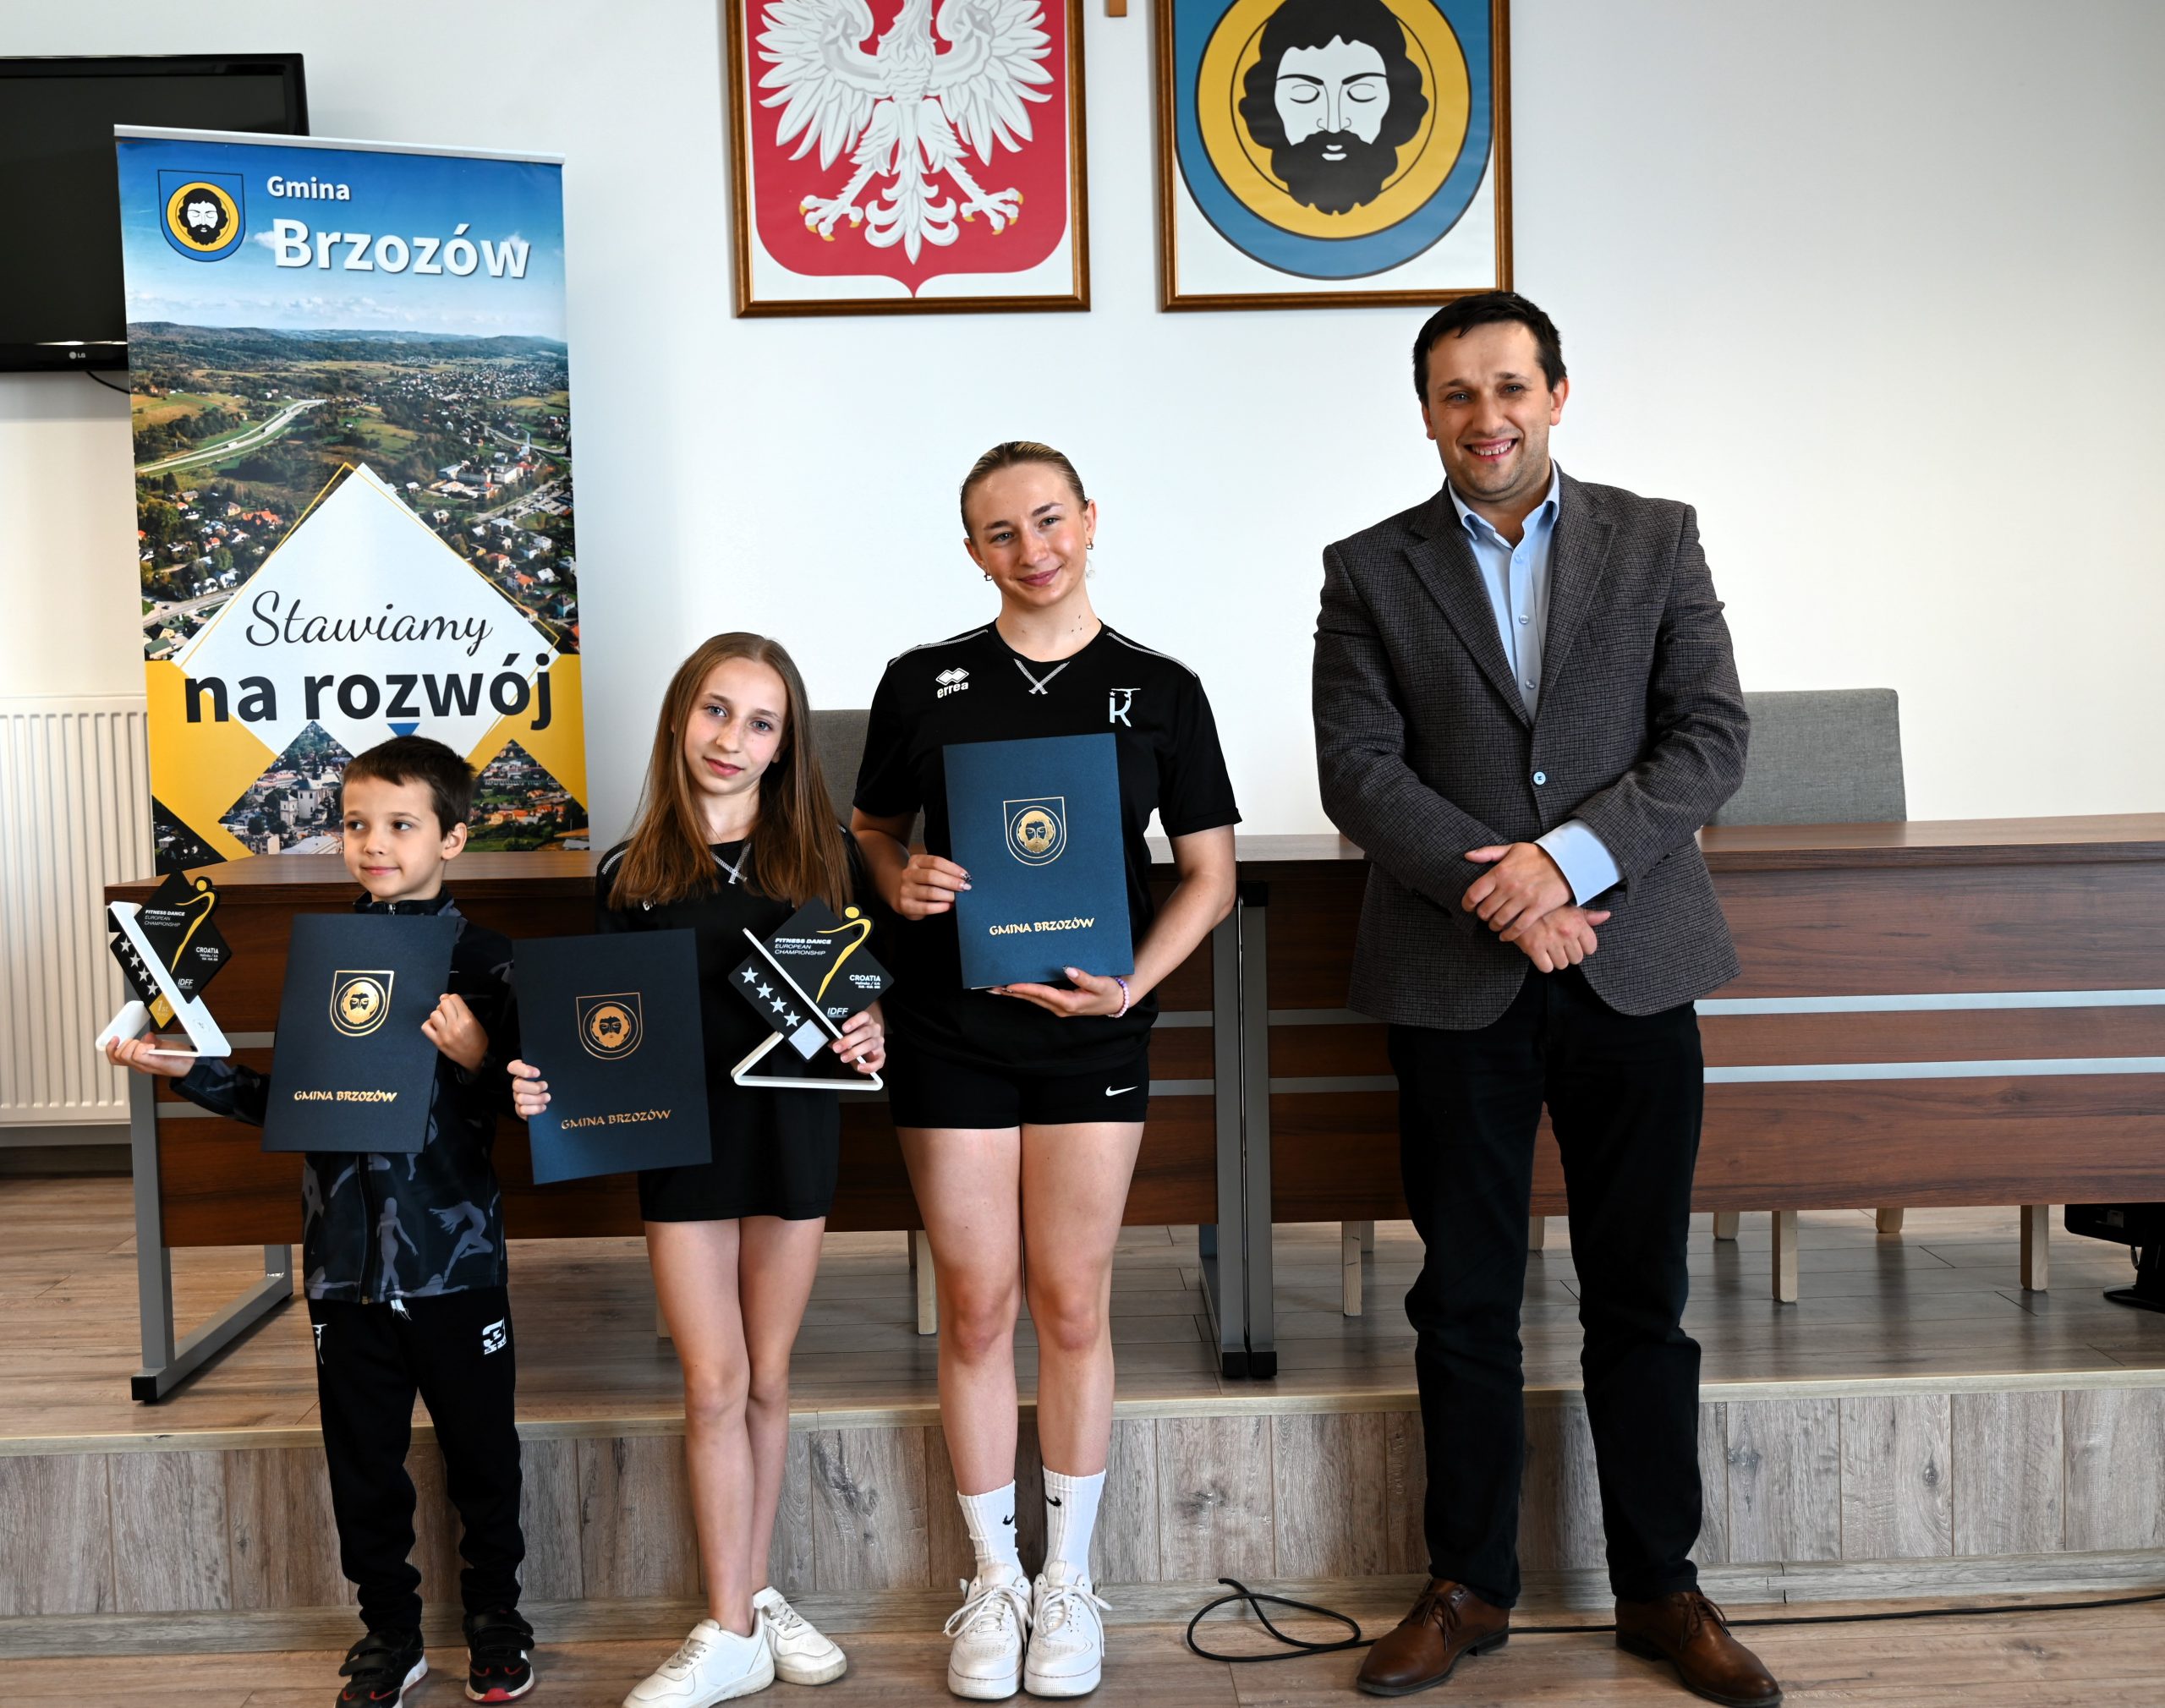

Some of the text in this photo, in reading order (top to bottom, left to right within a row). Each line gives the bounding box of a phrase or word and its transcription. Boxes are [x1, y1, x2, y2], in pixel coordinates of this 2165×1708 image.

[266, 174, 351, 201] Gmina
[271, 218, 530, 278] Brzozów
[245, 590, 493, 657] Stawiamy
[184, 653, 551, 731] na rozwój
[936, 682, 969, 699] errea
[989, 917, 1095, 936] GMINA BRZOZÓW
[827, 1007, 848, 1015] IDFF
[293, 1089, 397, 1103] GMINA BRZOZÓW
[562, 1109, 671, 1130] GMINA BRZOZÓW
